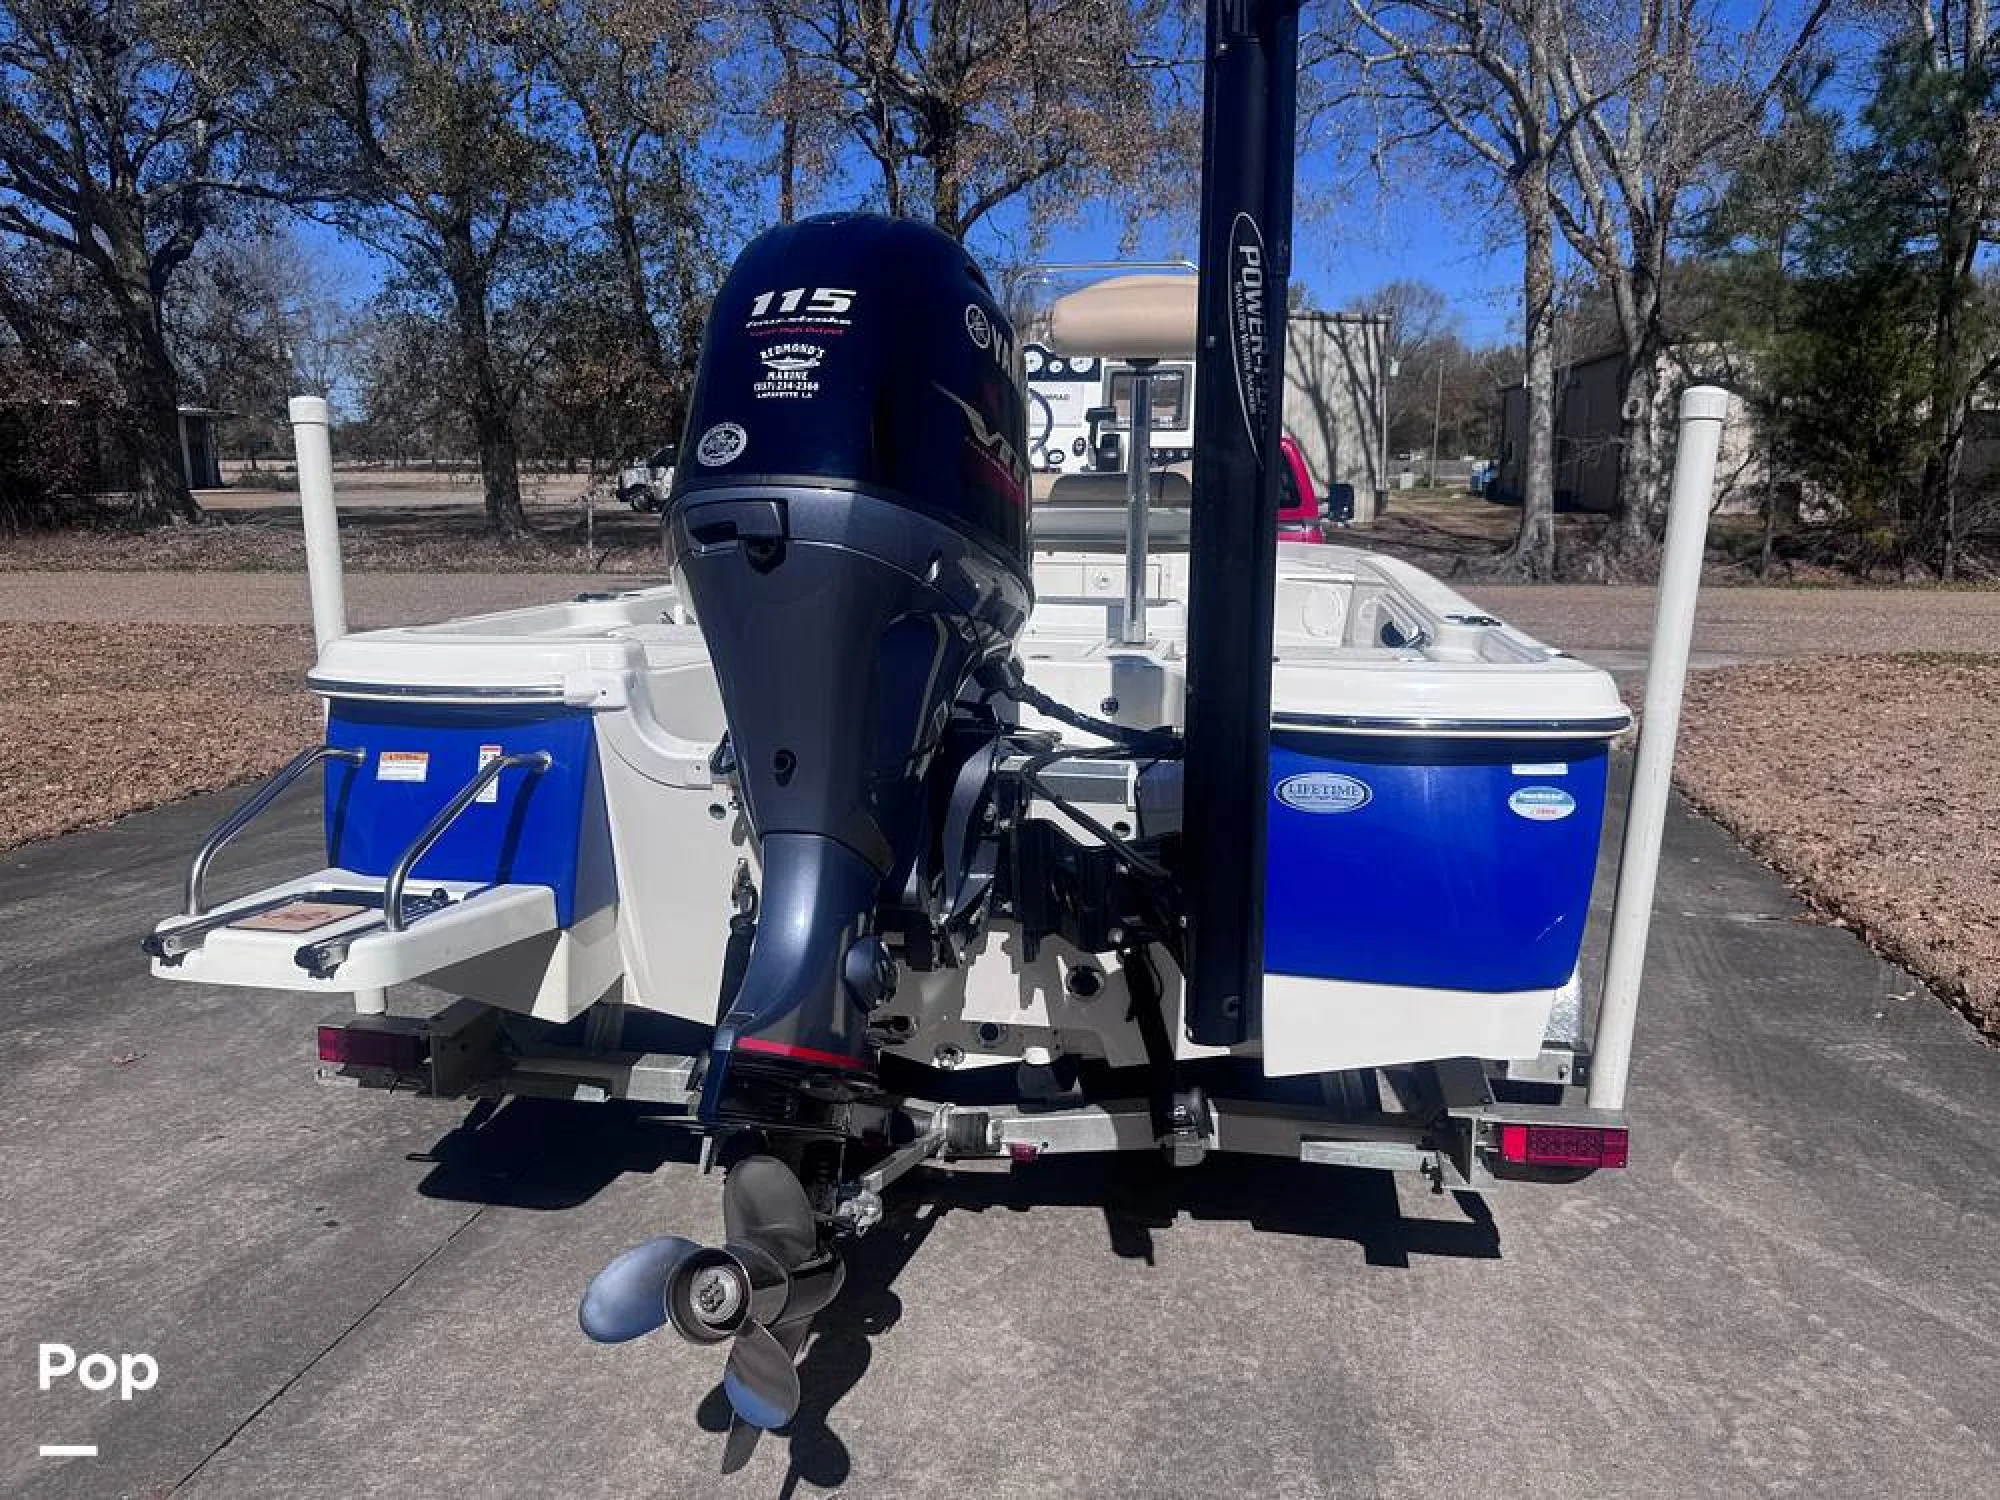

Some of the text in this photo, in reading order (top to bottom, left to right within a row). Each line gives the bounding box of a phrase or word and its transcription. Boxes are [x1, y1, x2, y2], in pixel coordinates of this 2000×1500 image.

[752, 288, 857, 316] 115
[766, 371, 809, 381] MARINE
[1288, 783, 1360, 796] LIFETIME
